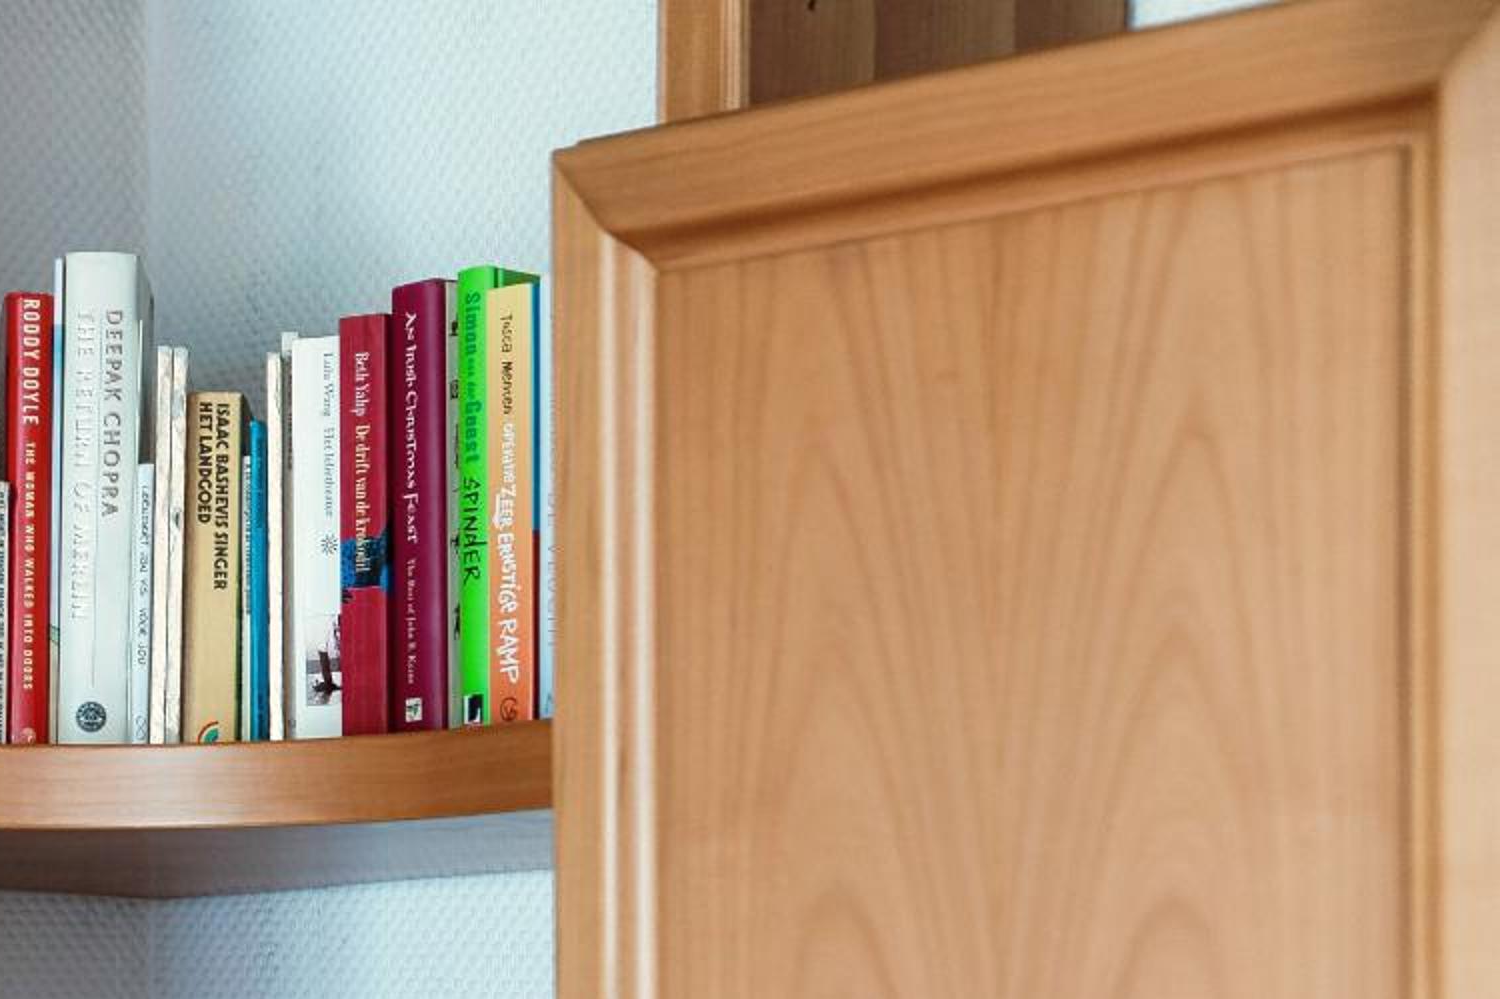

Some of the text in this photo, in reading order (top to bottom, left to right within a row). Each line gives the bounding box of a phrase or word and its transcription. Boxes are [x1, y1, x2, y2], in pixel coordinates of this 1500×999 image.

[77, 310, 94, 357] THE
[465, 291, 481, 354] Simon
[500, 314, 514, 354] Tosca
[323, 352, 334, 380] Lulu
[501, 360, 516, 415] Menten
[74, 369, 93, 468] RETURN
[100, 309, 124, 519] DEEPAK CHOPRA
[321, 382, 334, 417] Wang
[465, 400, 482, 463] Geest
[22, 299, 41, 690] RODDY DOYLE THE WOMAN WHO WALKED INTO DOORS
[197, 401, 213, 524] HET LANDGOED
[350, 352, 370, 572] Beth Yahp De drift van de krokodil
[213, 403, 230, 590] ISAAC BASHEVIS SINGER
[71, 523, 90, 621] MERLIN
[496, 619, 521, 684] RAMP
